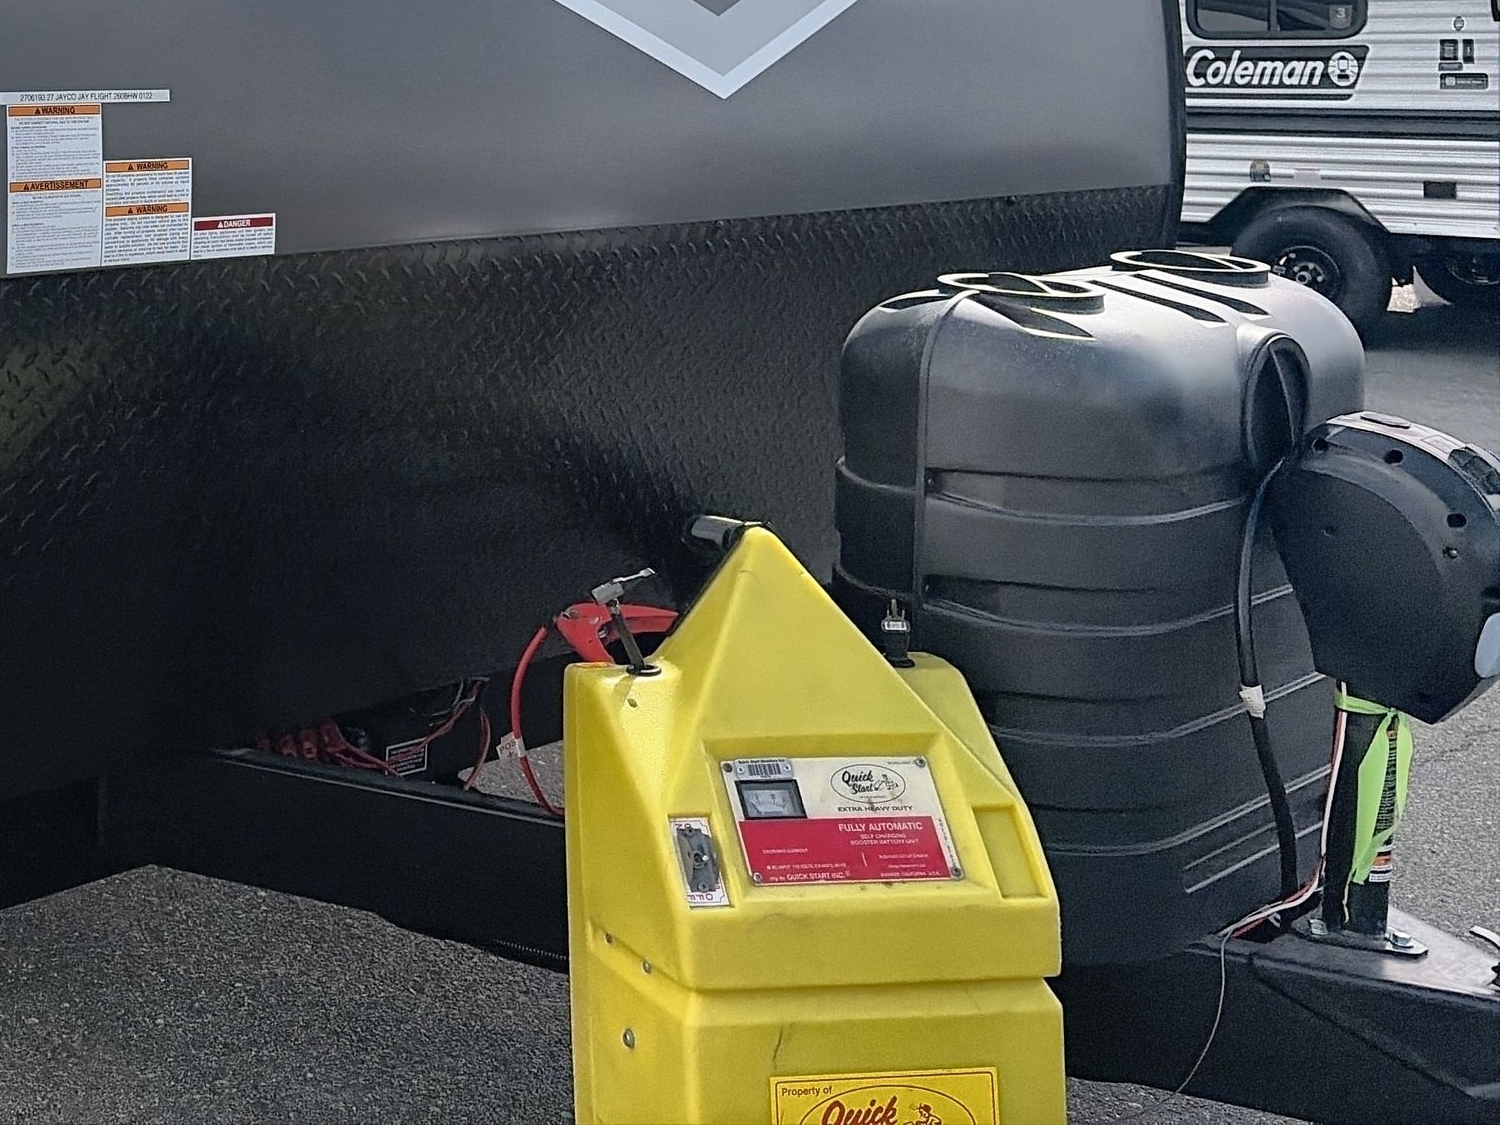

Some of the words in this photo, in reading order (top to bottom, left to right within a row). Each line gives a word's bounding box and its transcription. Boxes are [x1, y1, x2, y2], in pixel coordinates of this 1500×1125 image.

[1185, 49, 1325, 87] Coleman
[41, 106, 76, 115] WARNING
[136, 162, 168, 170] WARNING
[31, 180, 89, 190] AVERTISSEMENT
[136, 205, 168, 214] WARNING
[223, 219, 251, 228] DANGER
[499, 738, 517, 754] POS
[842, 770, 874, 787] Quick
[852, 782, 873, 795] Start
[838, 823, 868, 832] FULLY
[869, 821, 923, 831] AUTOMATIC
[781, 1086, 821, 1098] Property
[823, 1085, 833, 1094] of
[821, 1095, 898, 1125] Quick
